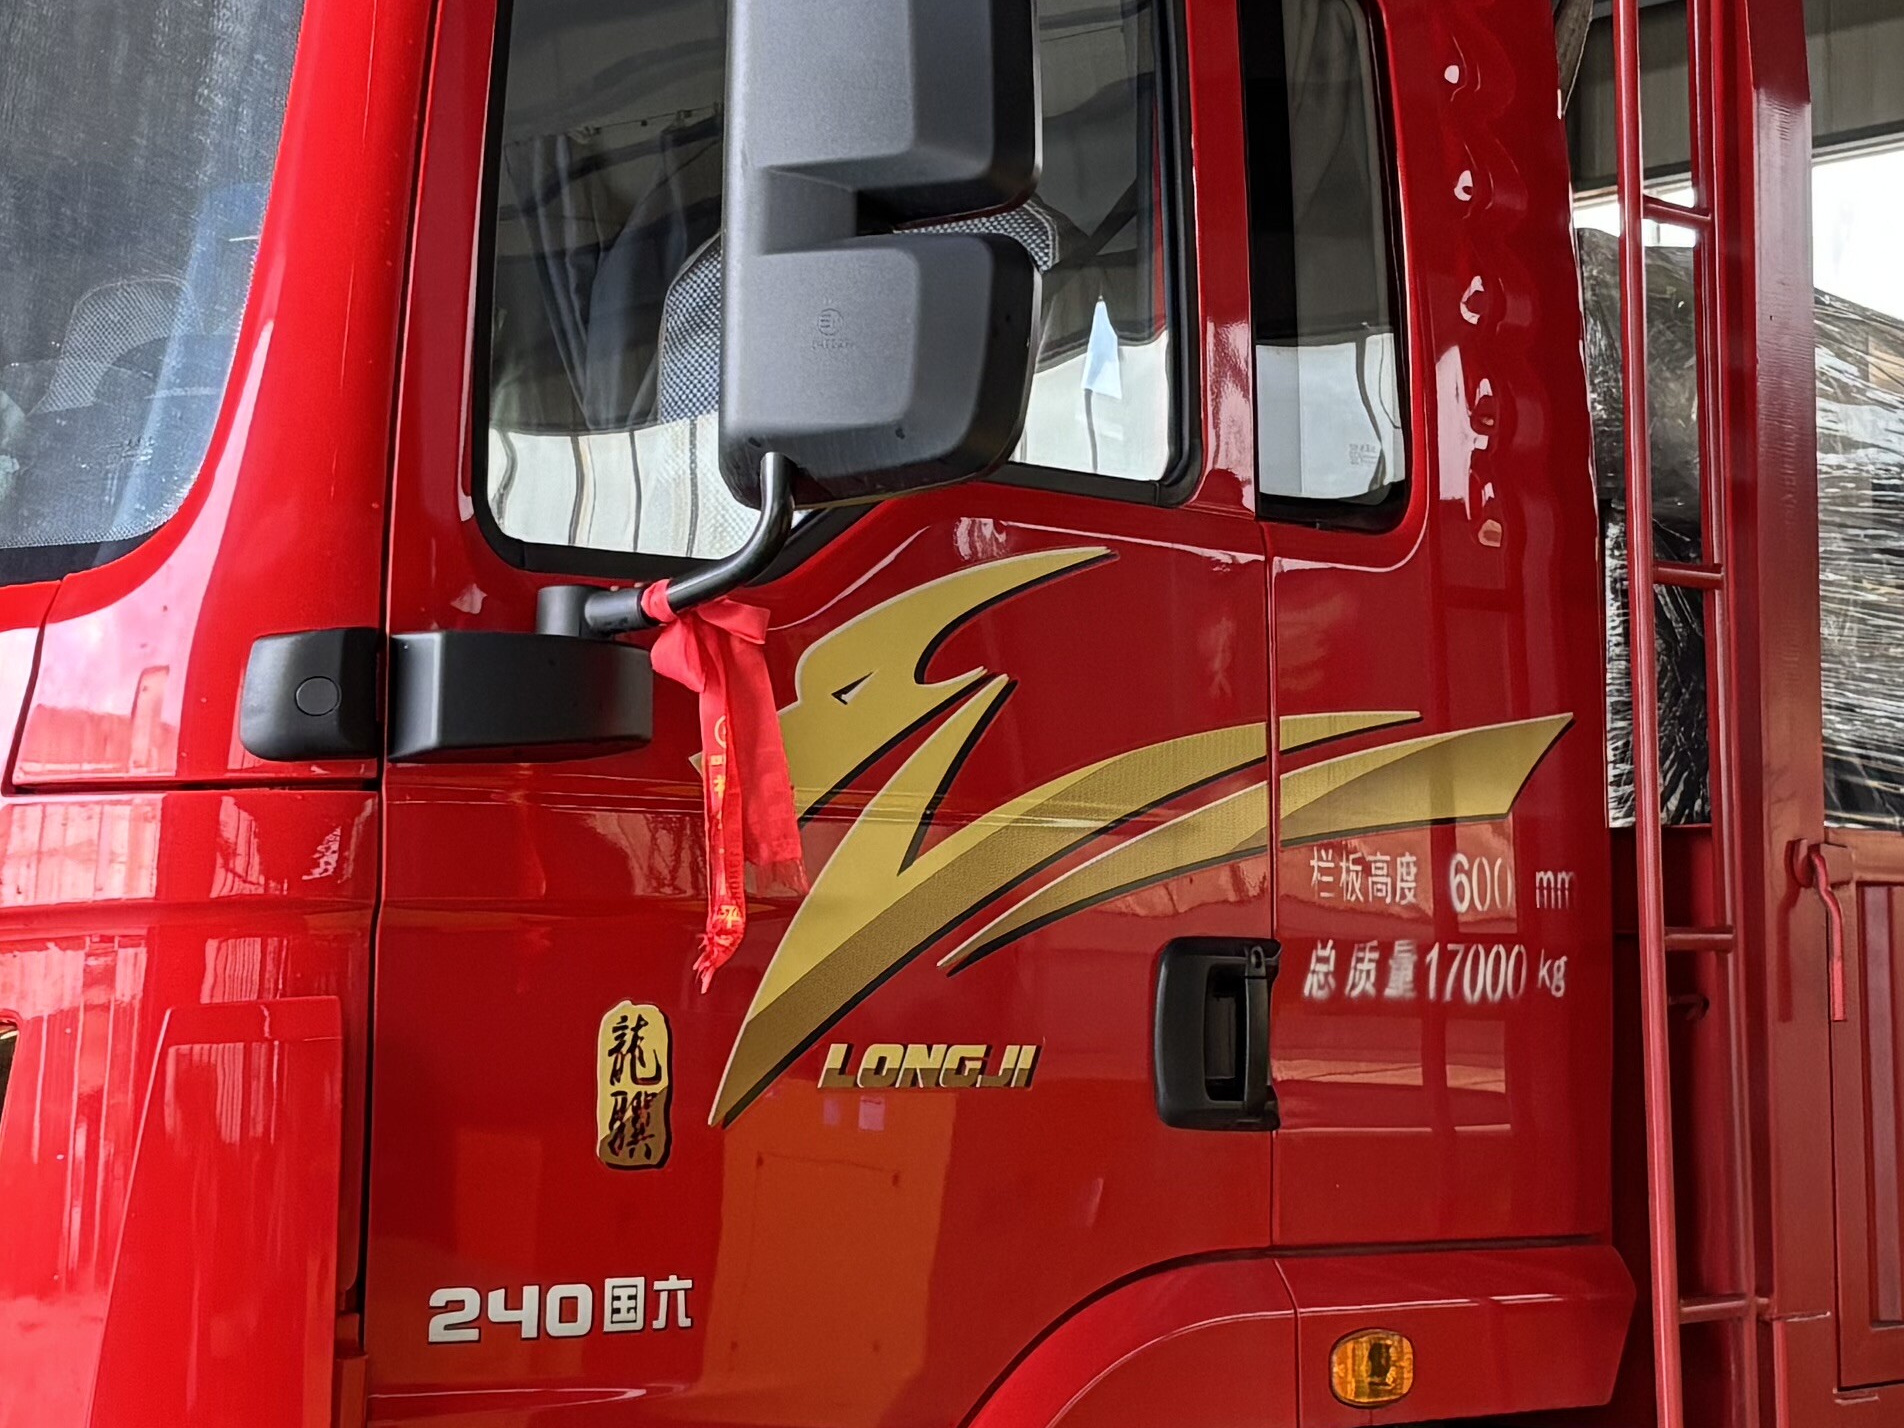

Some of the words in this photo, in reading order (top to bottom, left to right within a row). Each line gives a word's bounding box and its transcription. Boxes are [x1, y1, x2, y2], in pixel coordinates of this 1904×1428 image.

[1309, 846, 1419, 906] 栏板高度
[1449, 852, 1515, 915] 600
[1303, 938, 1419, 1001] 总质量
[1425, 942, 1527, 1005] 17000
[1536, 948, 1568, 998] kg
[817, 1043, 1042, 1090] LONGJI
